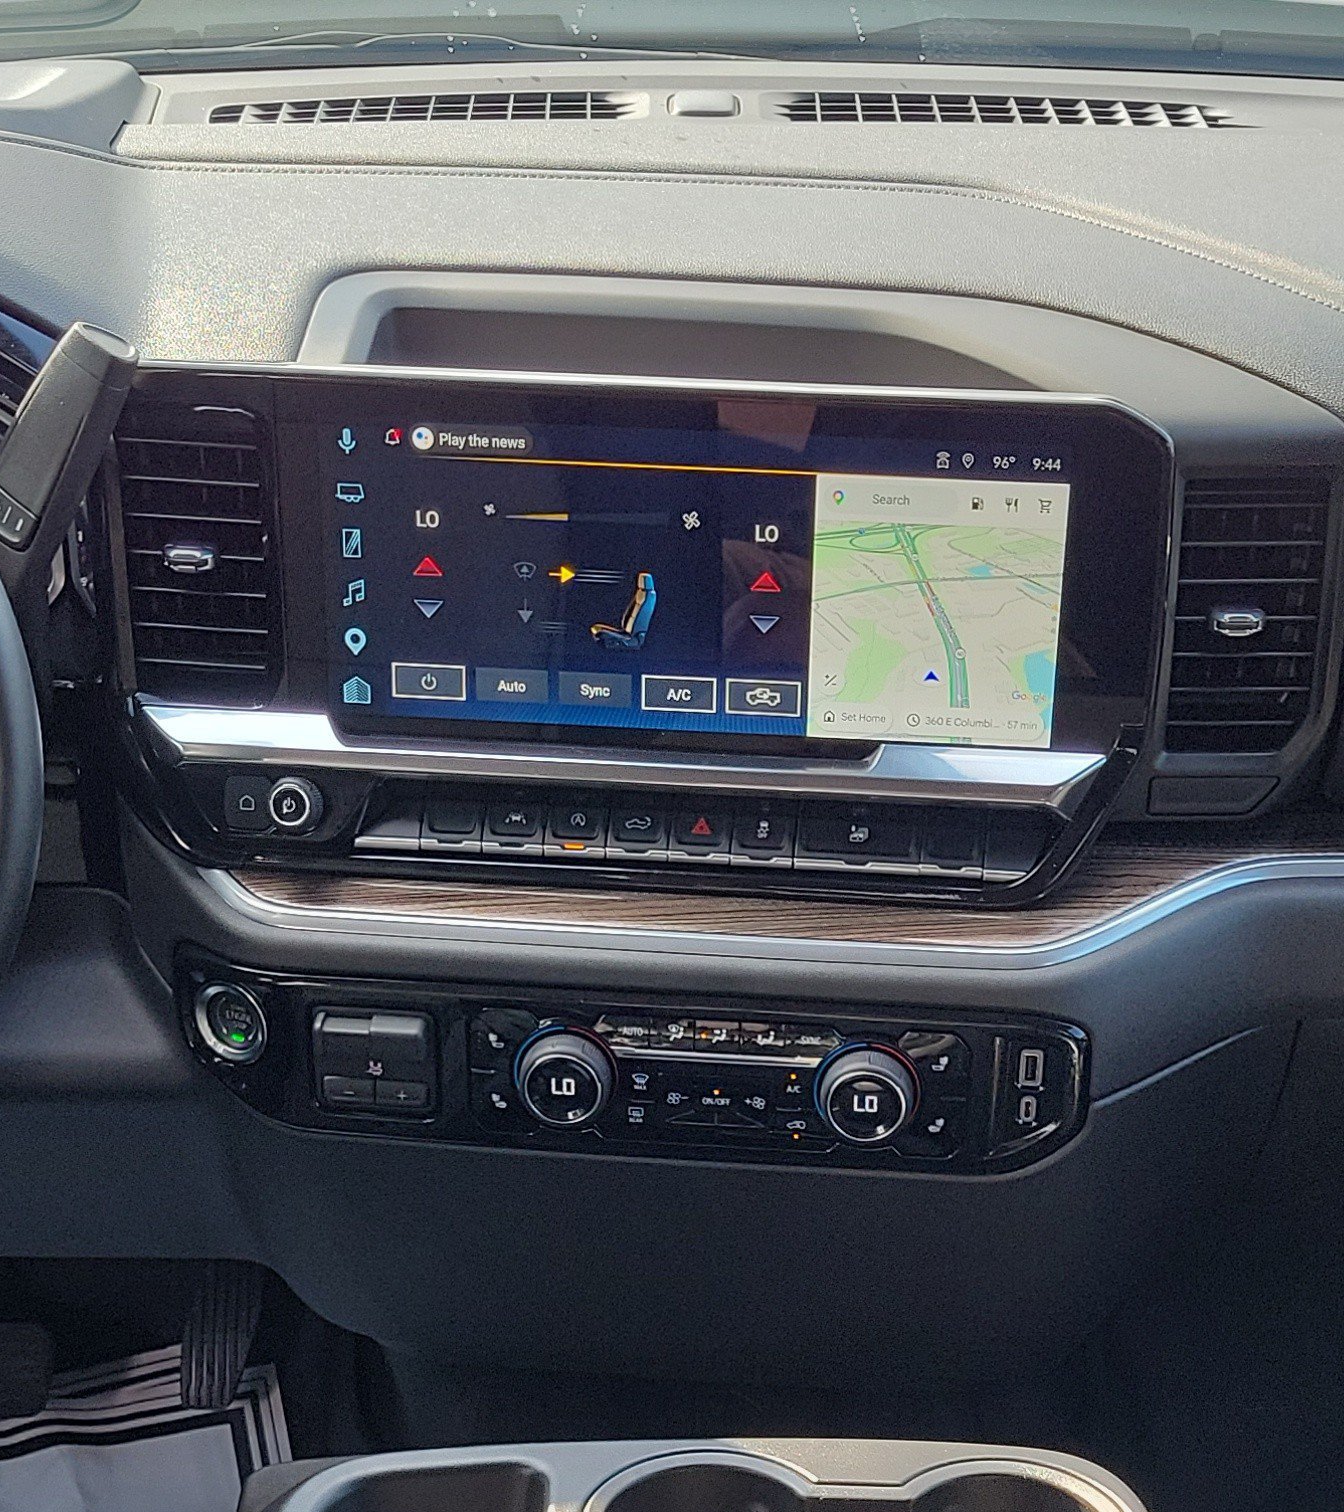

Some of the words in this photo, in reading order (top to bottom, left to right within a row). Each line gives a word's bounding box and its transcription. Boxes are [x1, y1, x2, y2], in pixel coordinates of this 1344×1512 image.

[439, 433, 466, 449] Play
[467, 434, 489, 448] the
[491, 437, 526, 449] news
[992, 455, 1016, 468] 96°
[1032, 457, 1062, 471] 9:44
[872, 493, 911, 506] Search
[415, 509, 440, 528] LO
[754, 524, 779, 543] LO
[497, 680, 527, 693] Auto
[580, 683, 611, 700] Sync
[666, 688, 692, 702] A/C
[841, 712, 857, 722] Set
[859, 713, 886, 723] Home
[925, 716, 944, 726] 360
[1006, 720, 1018, 730] 57
[1020, 721, 1038, 730] min
[622, 1027, 644, 1036] AUTO
[550, 1077, 576, 1096] LO
[786, 1085, 802, 1094] A/C
[702, 1097, 731, 1106] ON/OFF
[853, 1094, 878, 1113] LO
